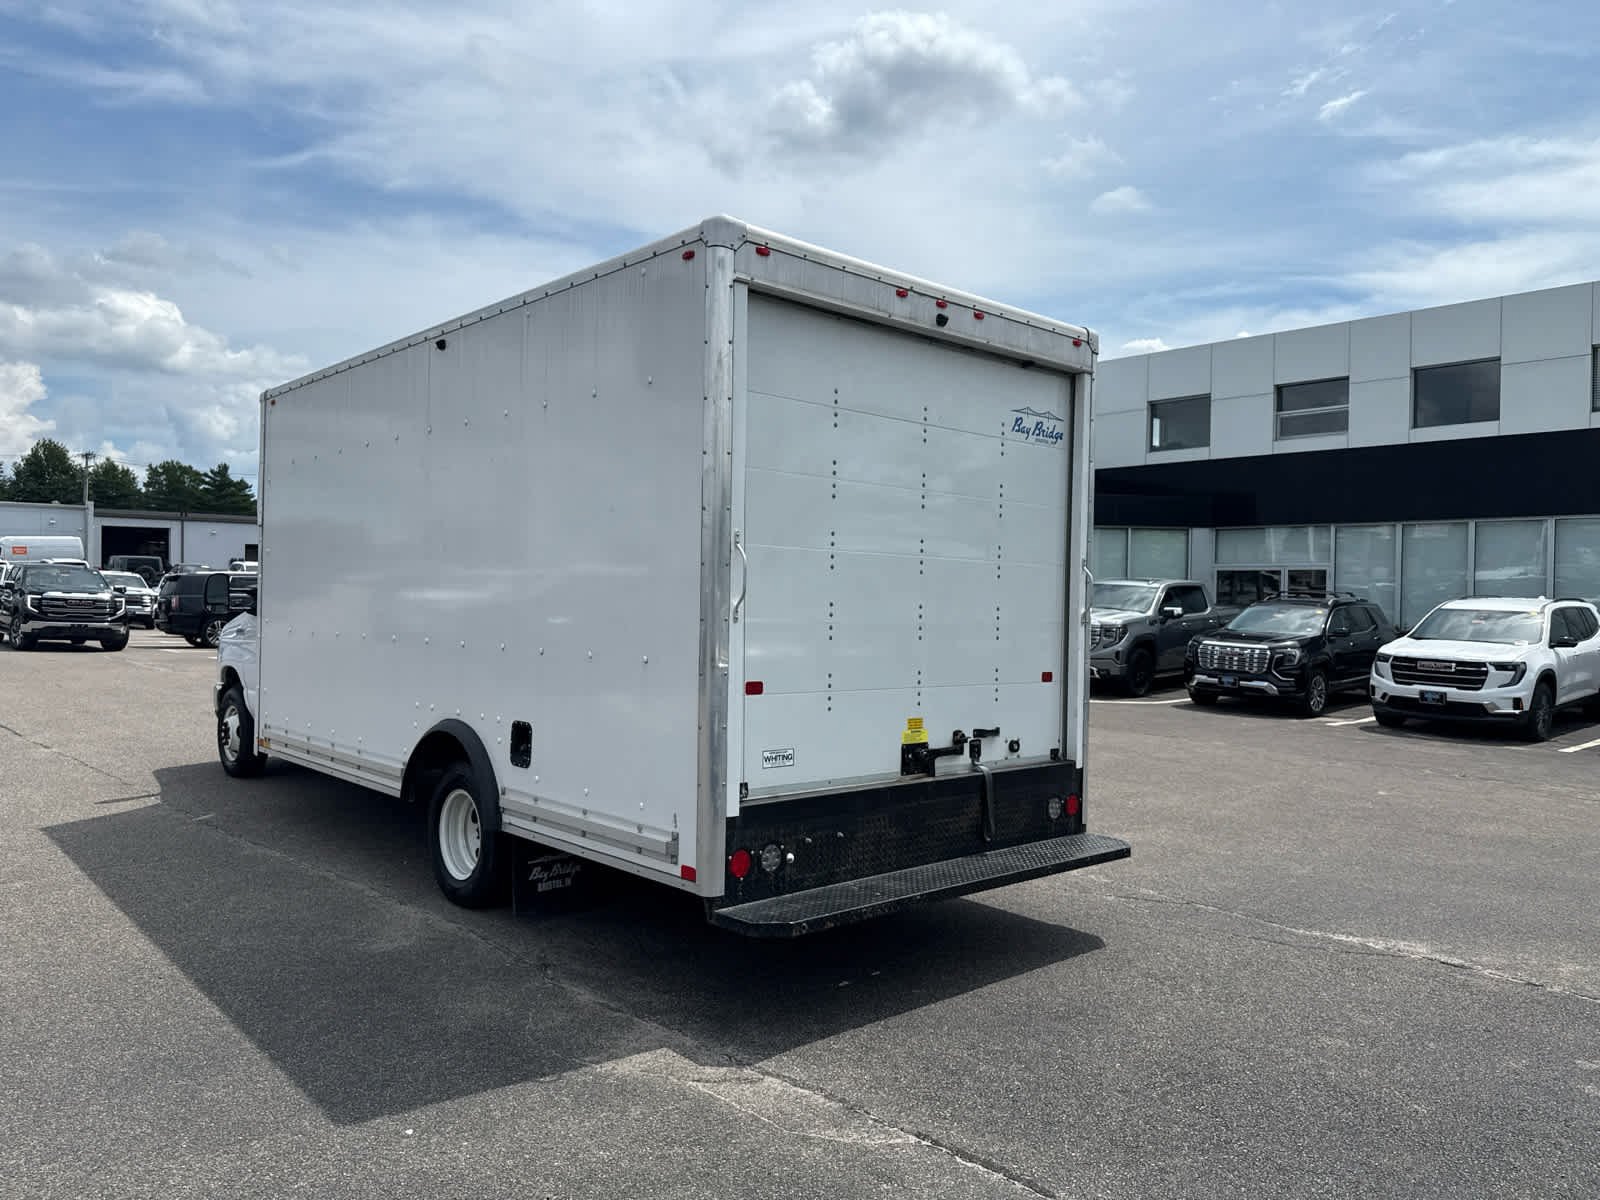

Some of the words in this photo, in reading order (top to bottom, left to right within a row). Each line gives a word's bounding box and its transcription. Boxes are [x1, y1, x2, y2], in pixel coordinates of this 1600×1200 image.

[1011, 416, 1031, 440] Bay
[1032, 421, 1064, 445] Bridge
[763, 754, 793, 763] WHITING
